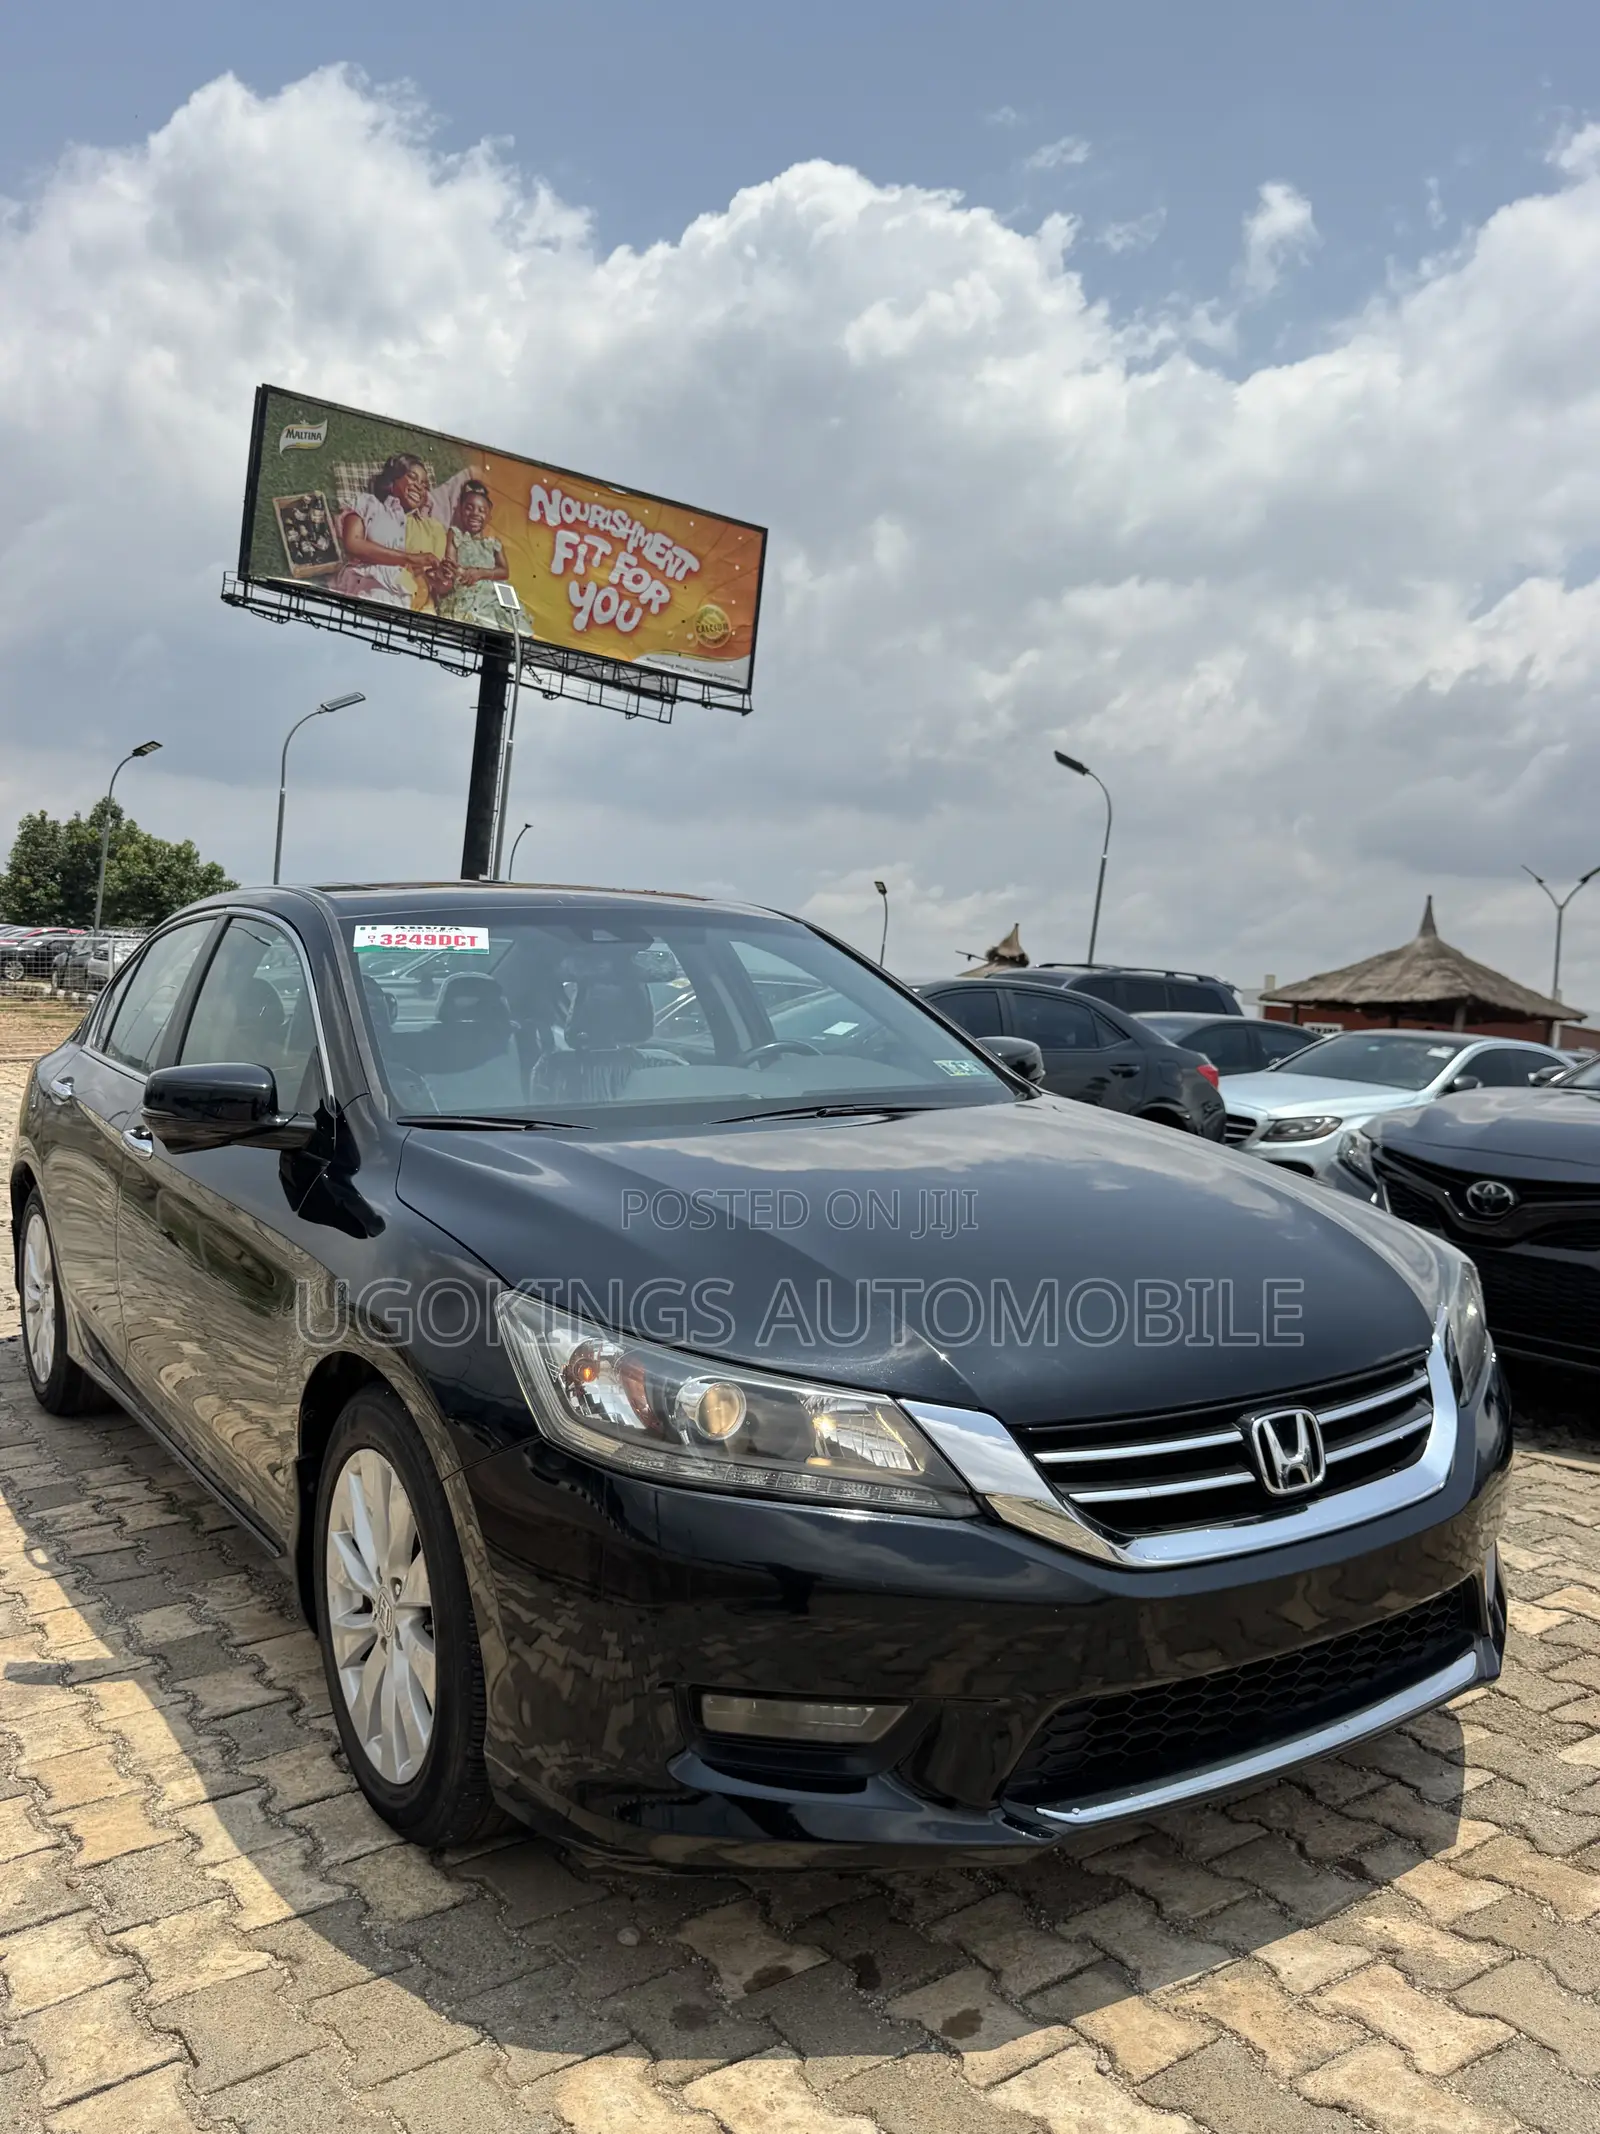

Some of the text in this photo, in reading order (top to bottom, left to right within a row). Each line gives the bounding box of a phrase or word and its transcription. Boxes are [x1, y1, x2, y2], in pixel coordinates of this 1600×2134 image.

[529, 484, 700, 581] NOURISHMENT
[569, 580, 643, 632] YOU
[608, 552, 671, 614] FOR
[380, 934, 479, 947] 3249DCT
